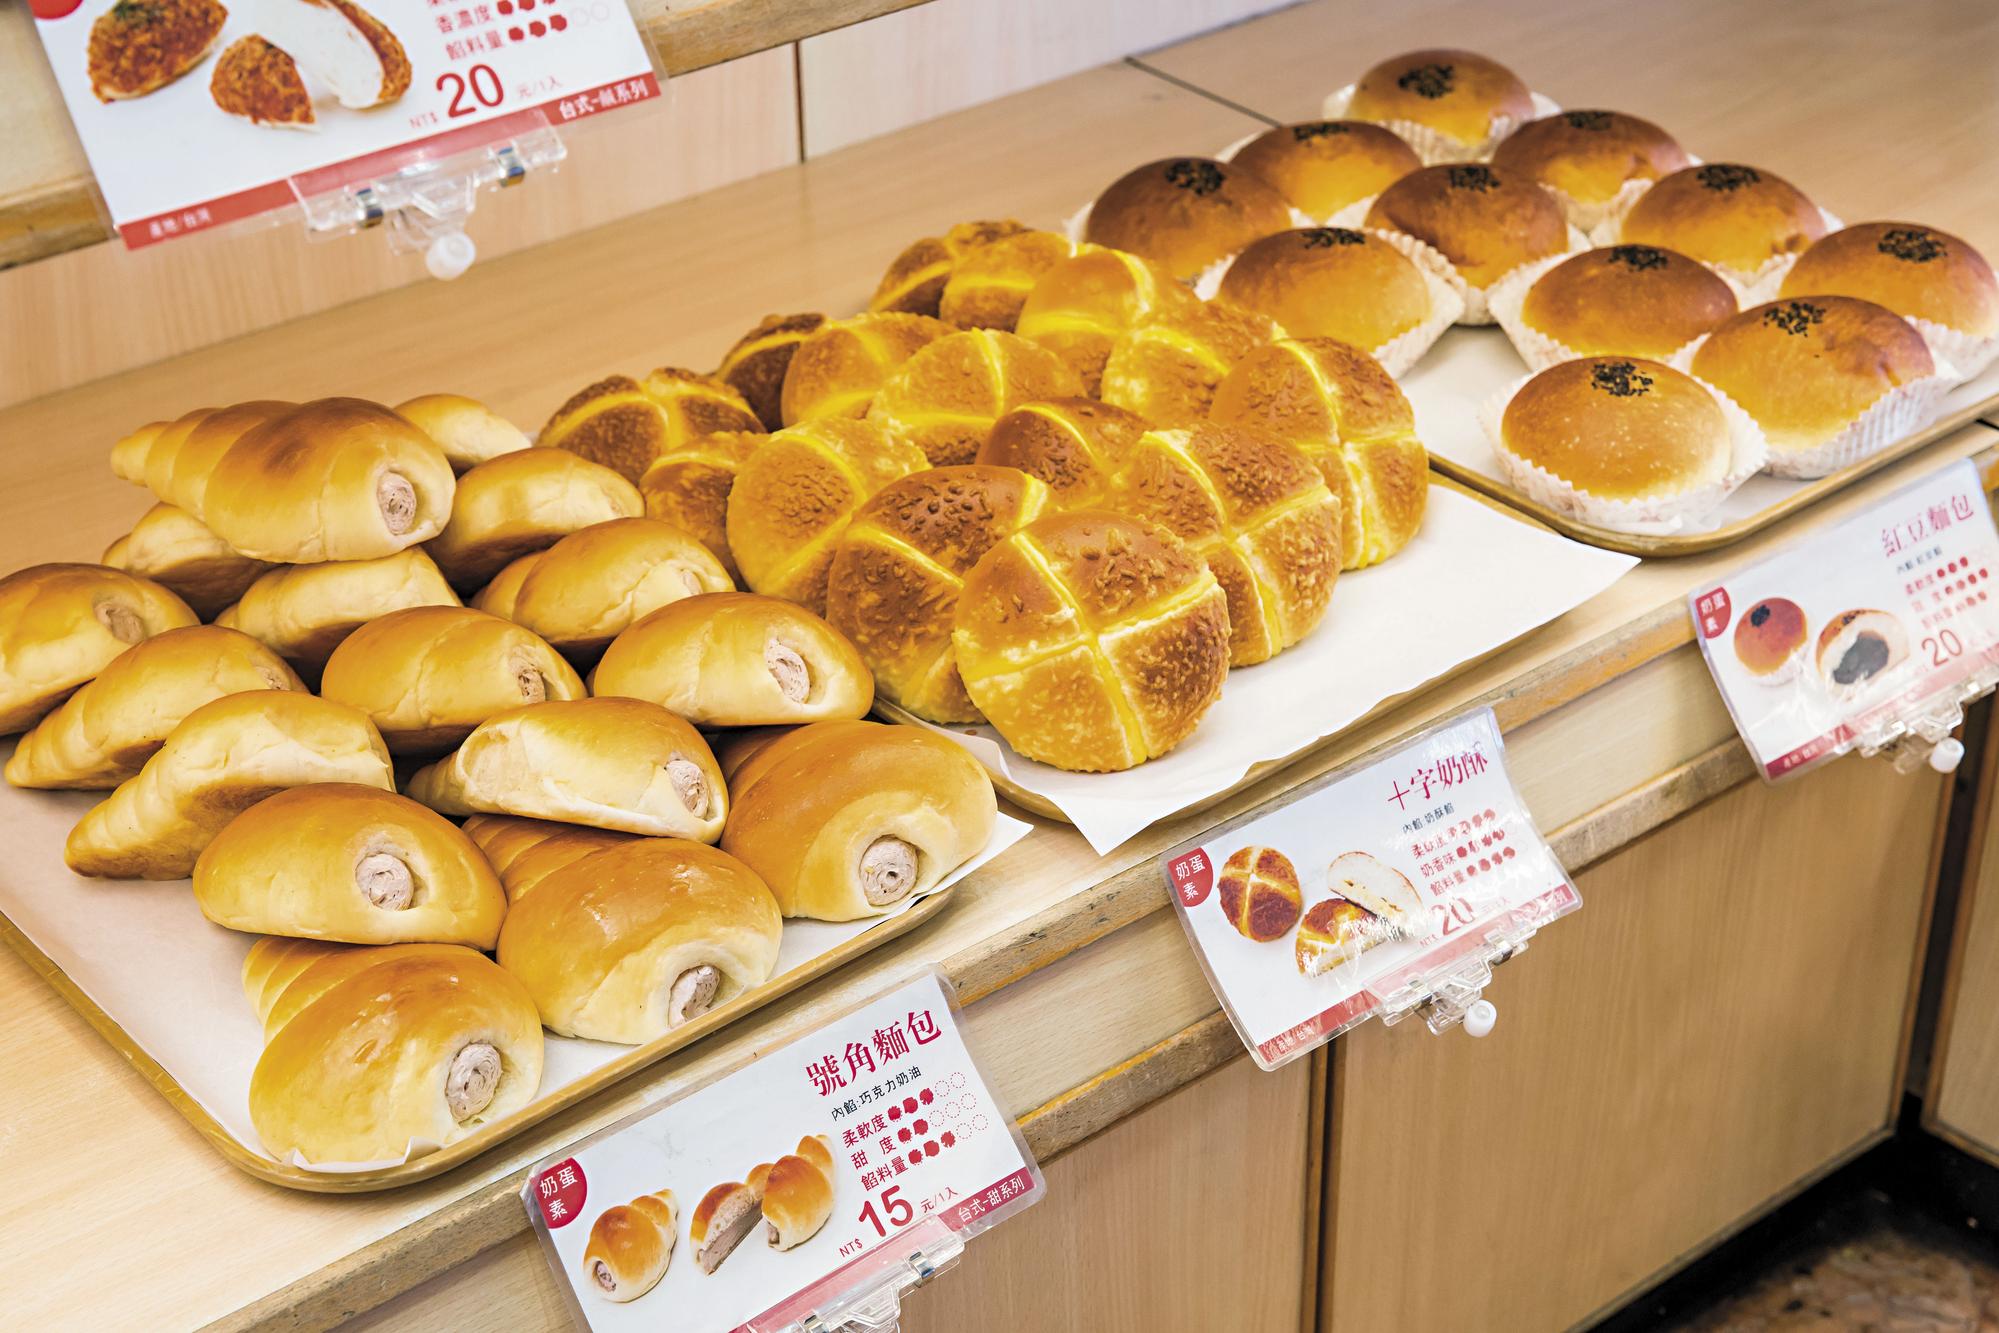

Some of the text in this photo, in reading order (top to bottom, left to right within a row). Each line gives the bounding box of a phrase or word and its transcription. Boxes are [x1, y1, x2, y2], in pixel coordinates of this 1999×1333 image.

[435, 63, 504, 119] 20
[1921, 629, 1962, 667] 20
[1387, 751, 1488, 811] 十字奶酥
[1431, 897, 1475, 936] 20
[805, 1009, 942, 1097] 號角麵包
[842, 1114, 888, 1148] 柔軟度
[861, 1156, 908, 1191] 餡料量
[839, 1238, 863, 1258] NT$
[858, 1184, 914, 1237] 15
